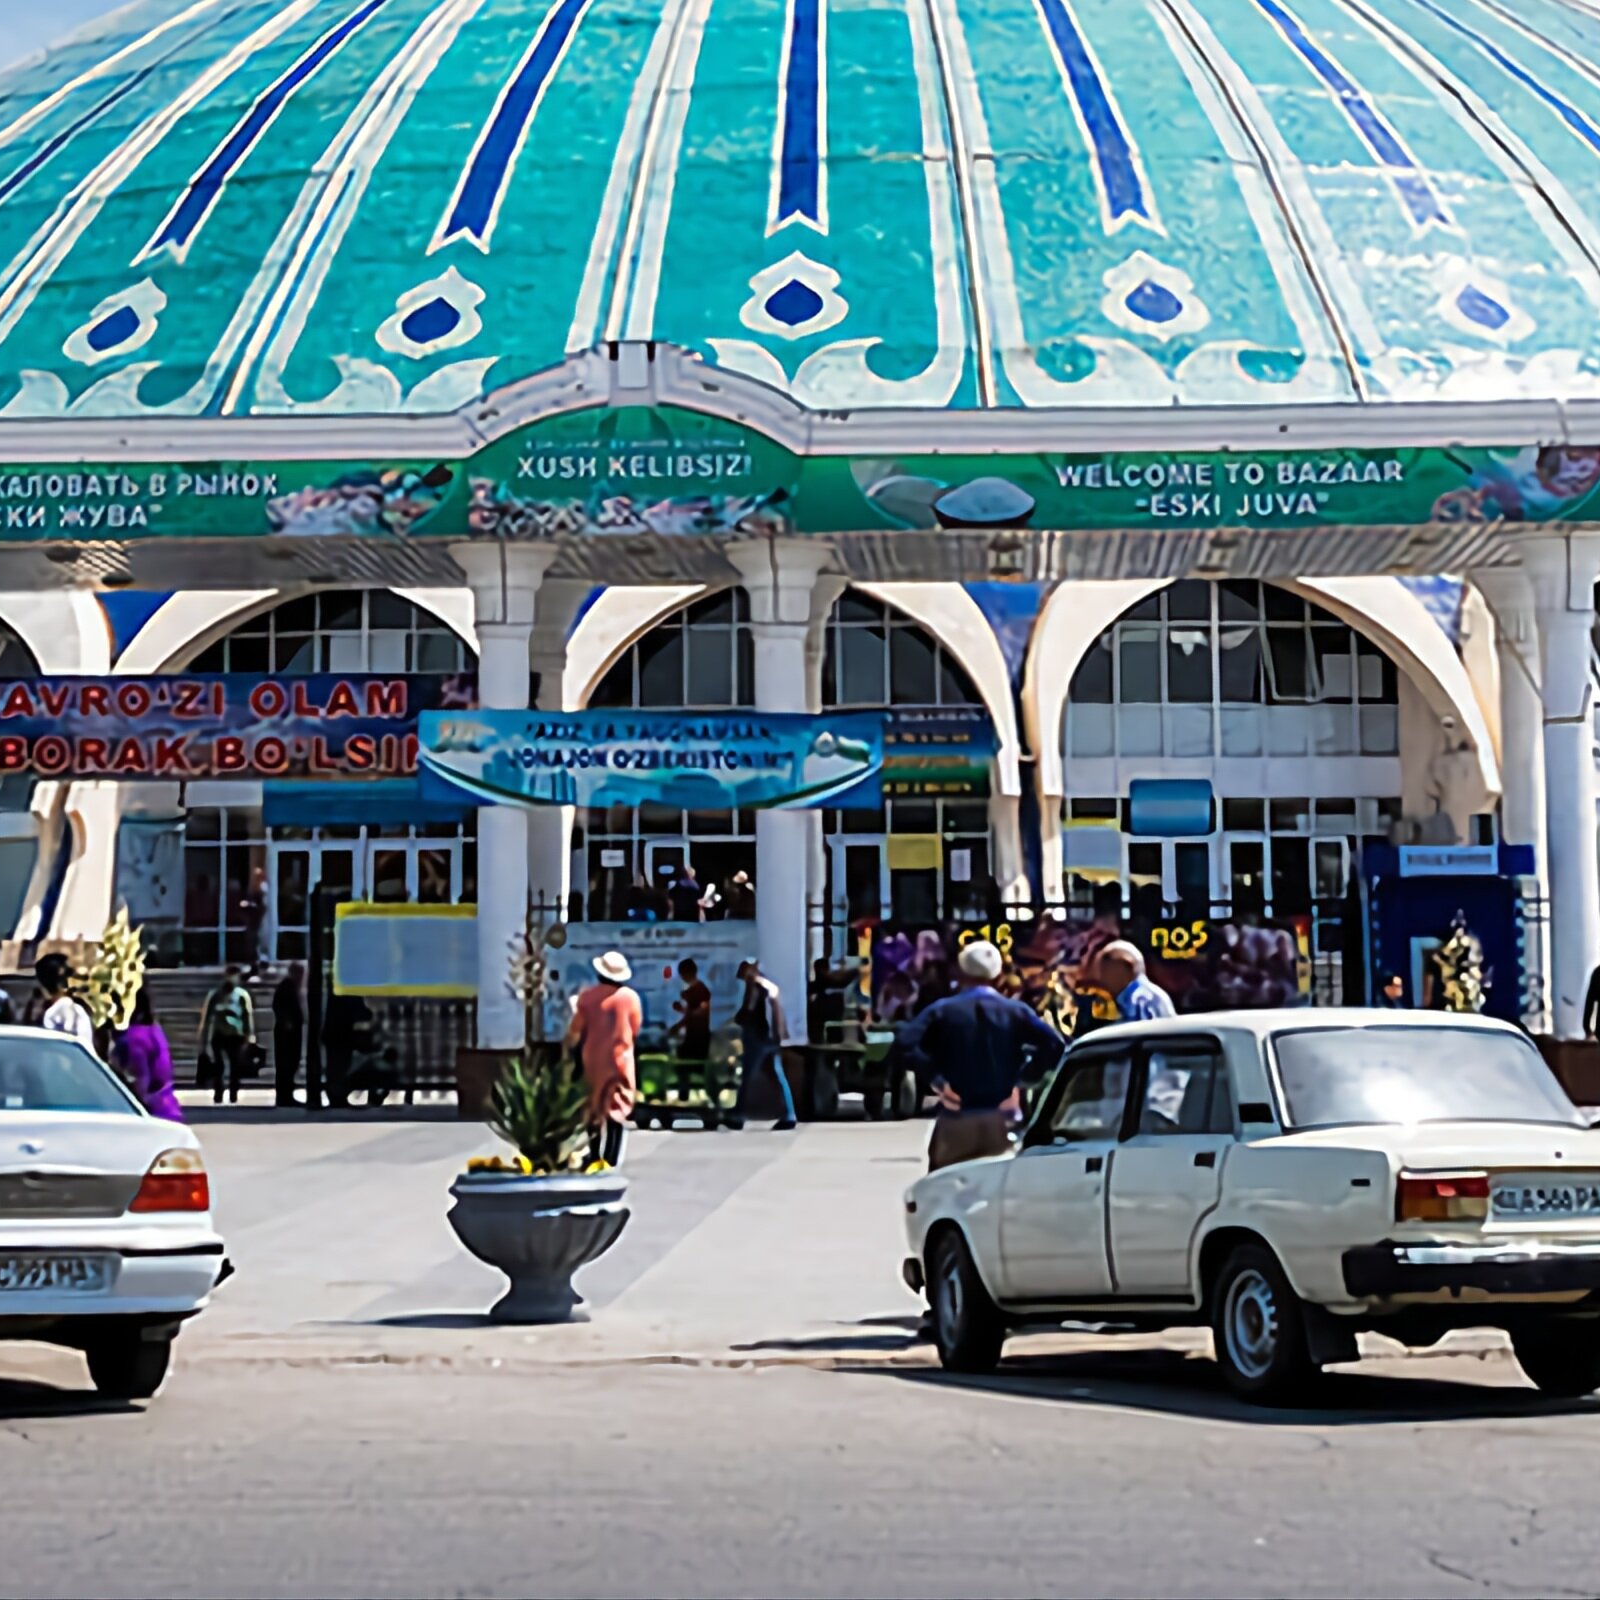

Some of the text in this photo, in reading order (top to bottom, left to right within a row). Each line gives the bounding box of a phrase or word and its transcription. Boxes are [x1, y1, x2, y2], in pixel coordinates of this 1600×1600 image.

[517, 456, 597, 479] XUSH
[1055, 460, 1404, 488] WELCOME TO BAZAAR
[148, 474, 167, 498] В
[176, 473, 278, 497] РЫНОК
[249, 680, 409, 718] OLAM
